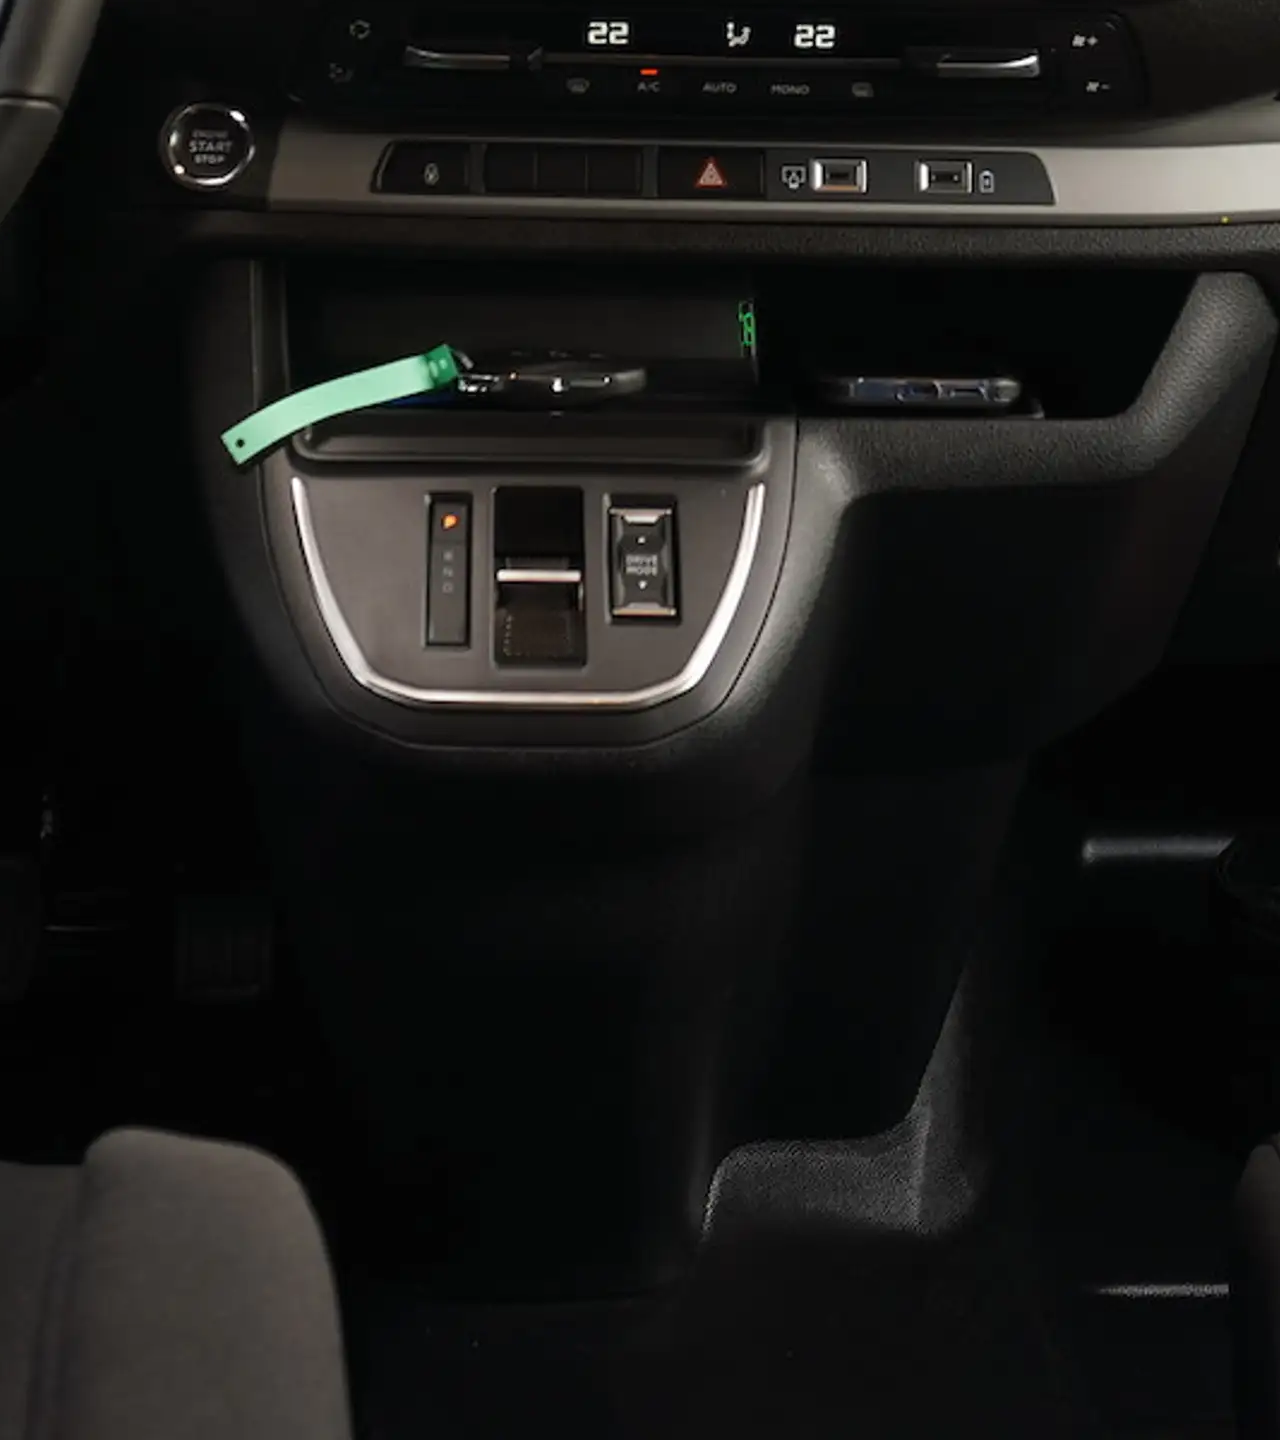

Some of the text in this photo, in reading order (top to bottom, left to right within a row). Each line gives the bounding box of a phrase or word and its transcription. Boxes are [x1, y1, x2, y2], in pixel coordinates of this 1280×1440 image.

[587, 21, 630, 45] 22
[793, 23, 836, 49] 22
[636, 80, 661, 93] A/C
[701, 81, 738, 94] AUTO
[770, 83, 811, 96] MONO
[188, 140, 233, 154] START
[194, 153, 226, 165] STOP
